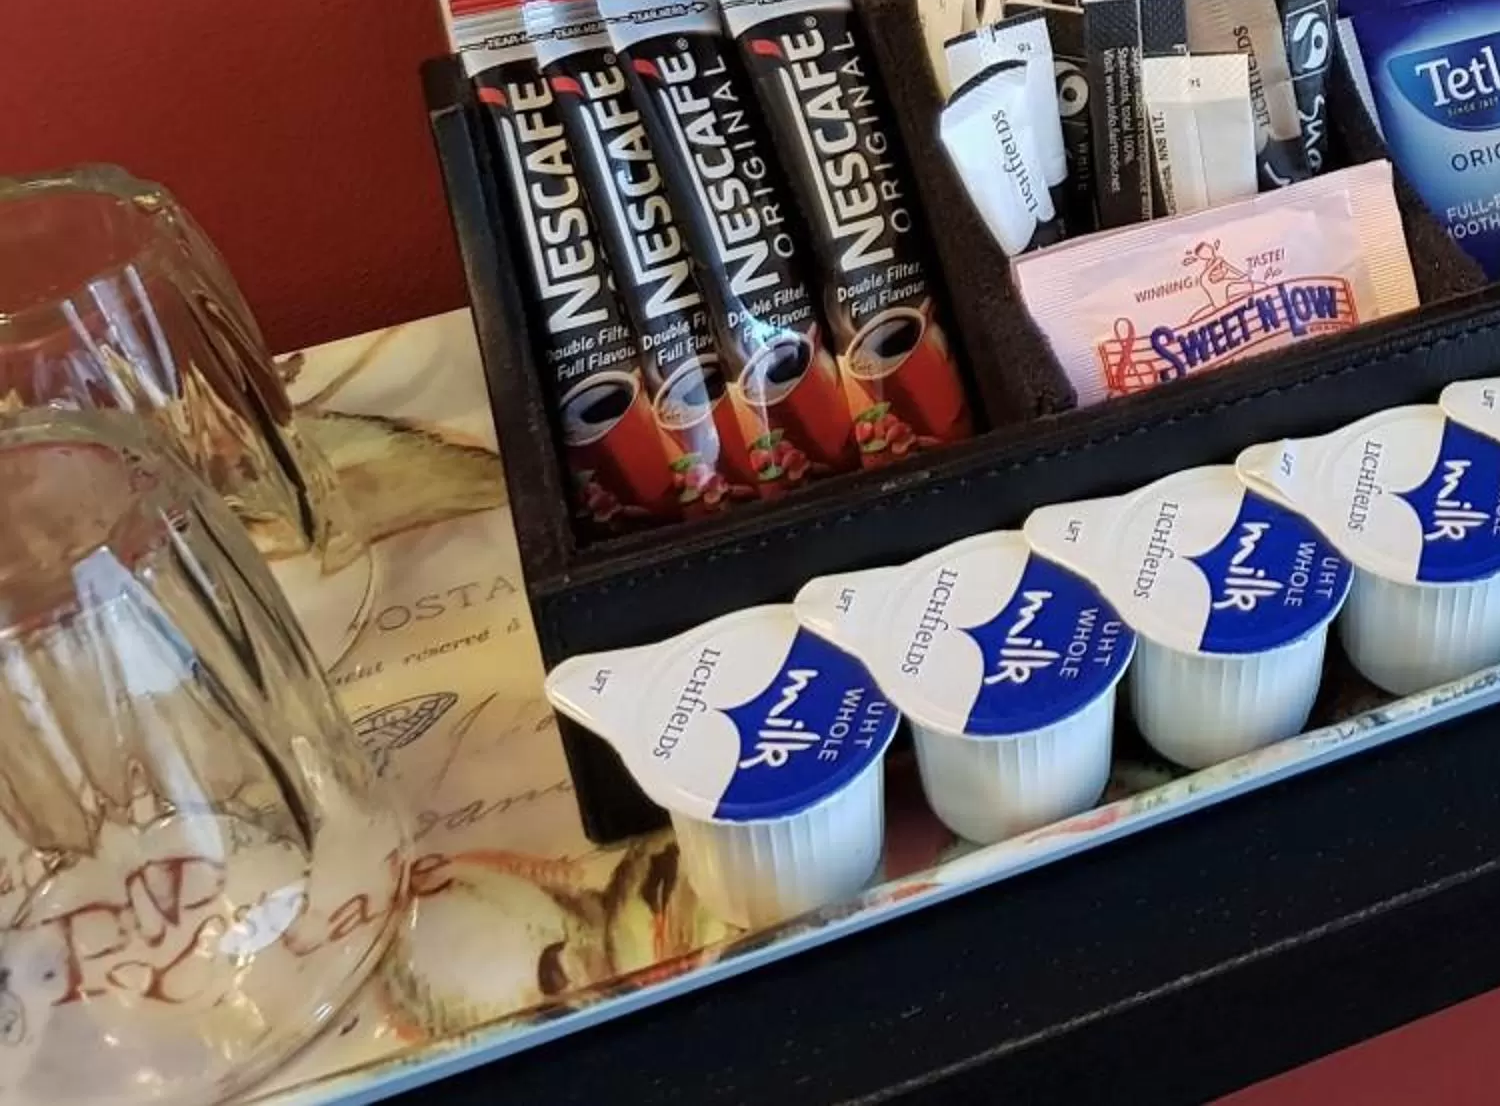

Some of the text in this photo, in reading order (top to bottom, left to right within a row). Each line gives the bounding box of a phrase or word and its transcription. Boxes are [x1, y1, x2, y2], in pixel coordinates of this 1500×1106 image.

[832, 32, 912, 233] ORIGINAL
[704, 55, 796, 258] ORIGINAL
[1448, 216, 1500, 238] OOTH
[837, 273, 885, 302] Double
[1134, 275, 1194, 303] WINNING
[851, 298, 877, 318] Full
[642, 320, 690, 350] Double
[557, 346, 636, 381] Full Flavou
[657, 343, 683, 366] Full
[1280, 452, 1295, 477] LIFT
[1064, 519, 1084, 544] LIFT
[1284, 540, 1317, 608] WHOLE
[1315, 556, 1341, 599] UHT
[374, 575, 519, 632] OSTA
[836, 588, 856, 614] LIFT
[1059, 607, 1099, 680] WHOLE
[1093, 620, 1123, 667] UHT
[590, 668, 612, 694] LIFT
[817, 687, 865, 763] WHOLE
[854, 701, 888, 750] UHT
